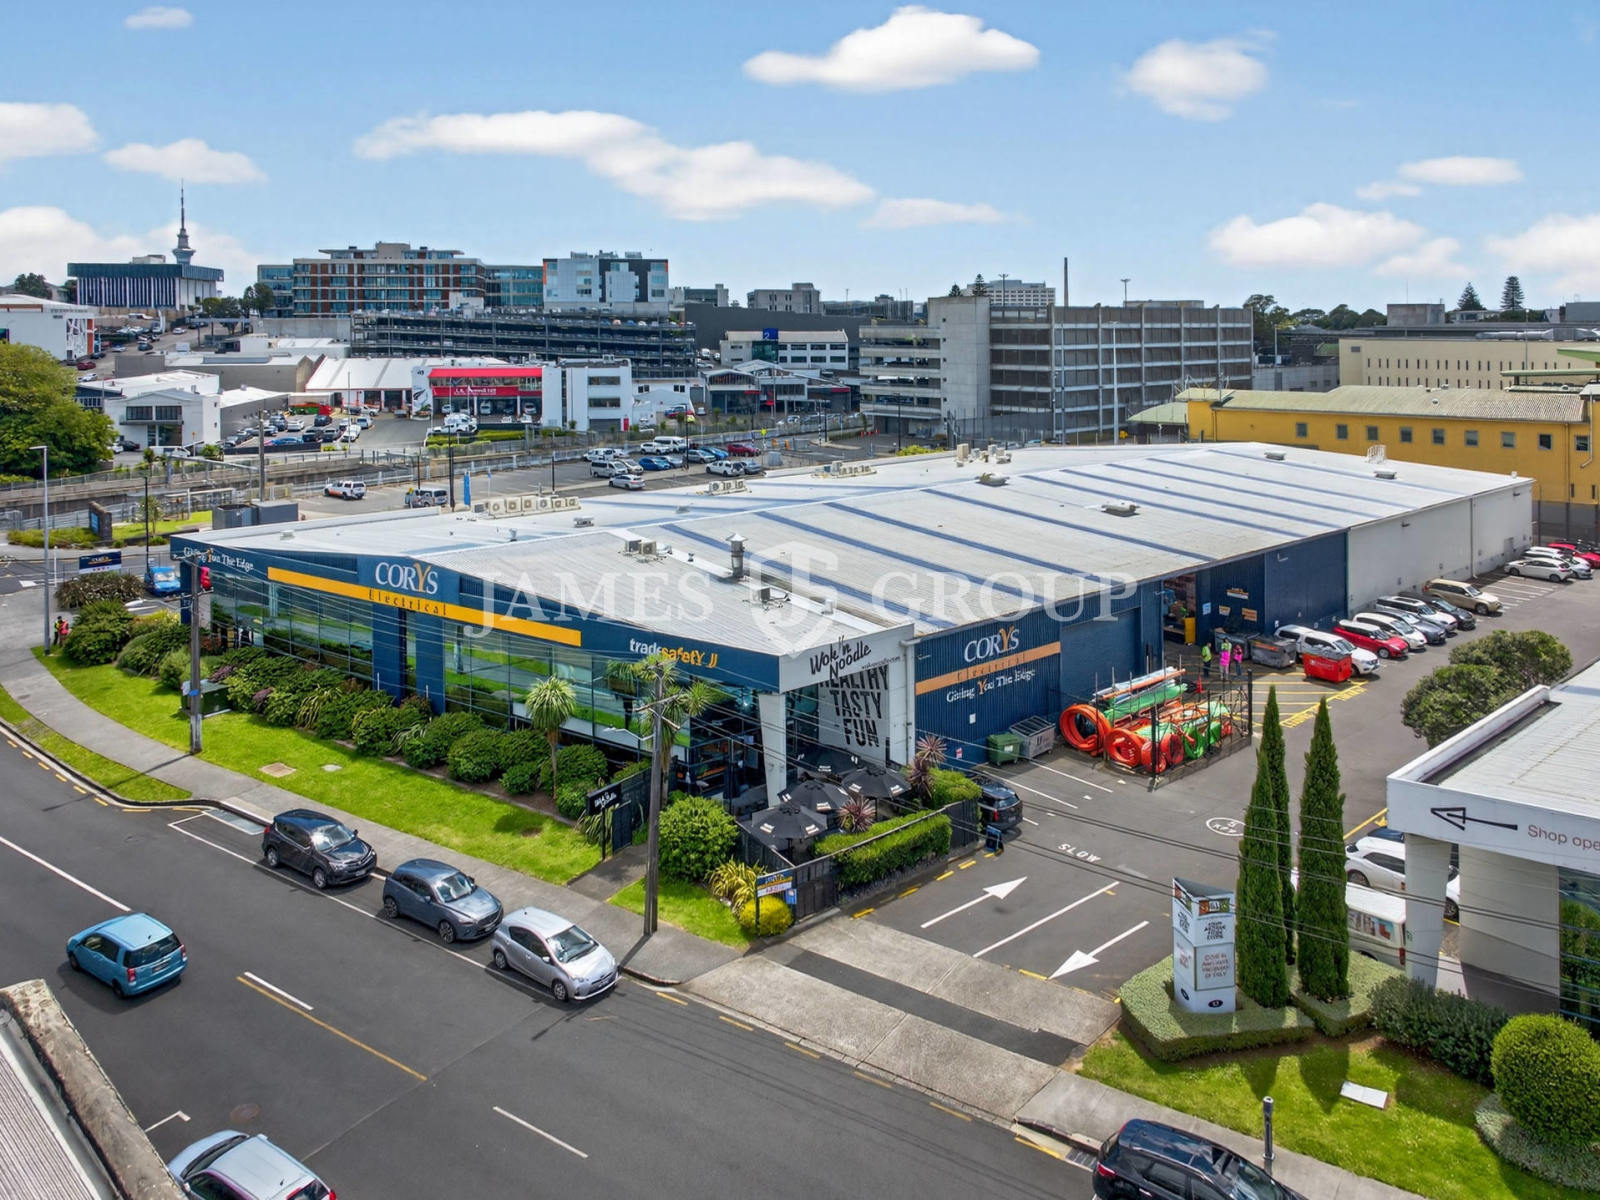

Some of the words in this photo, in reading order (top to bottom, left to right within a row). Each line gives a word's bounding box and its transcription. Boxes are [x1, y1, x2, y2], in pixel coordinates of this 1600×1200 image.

[375, 562, 439, 595] CORYS
[963, 626, 1020, 662] CORYS
[810, 644, 839, 675] Wok
[830, 641, 872, 680] Noodle
[829, 690, 882, 719] TASTY
[843, 718, 880, 747] FUN
[1528, 824, 1568, 846] Shop
[1058, 843, 1102, 863] SLOW
